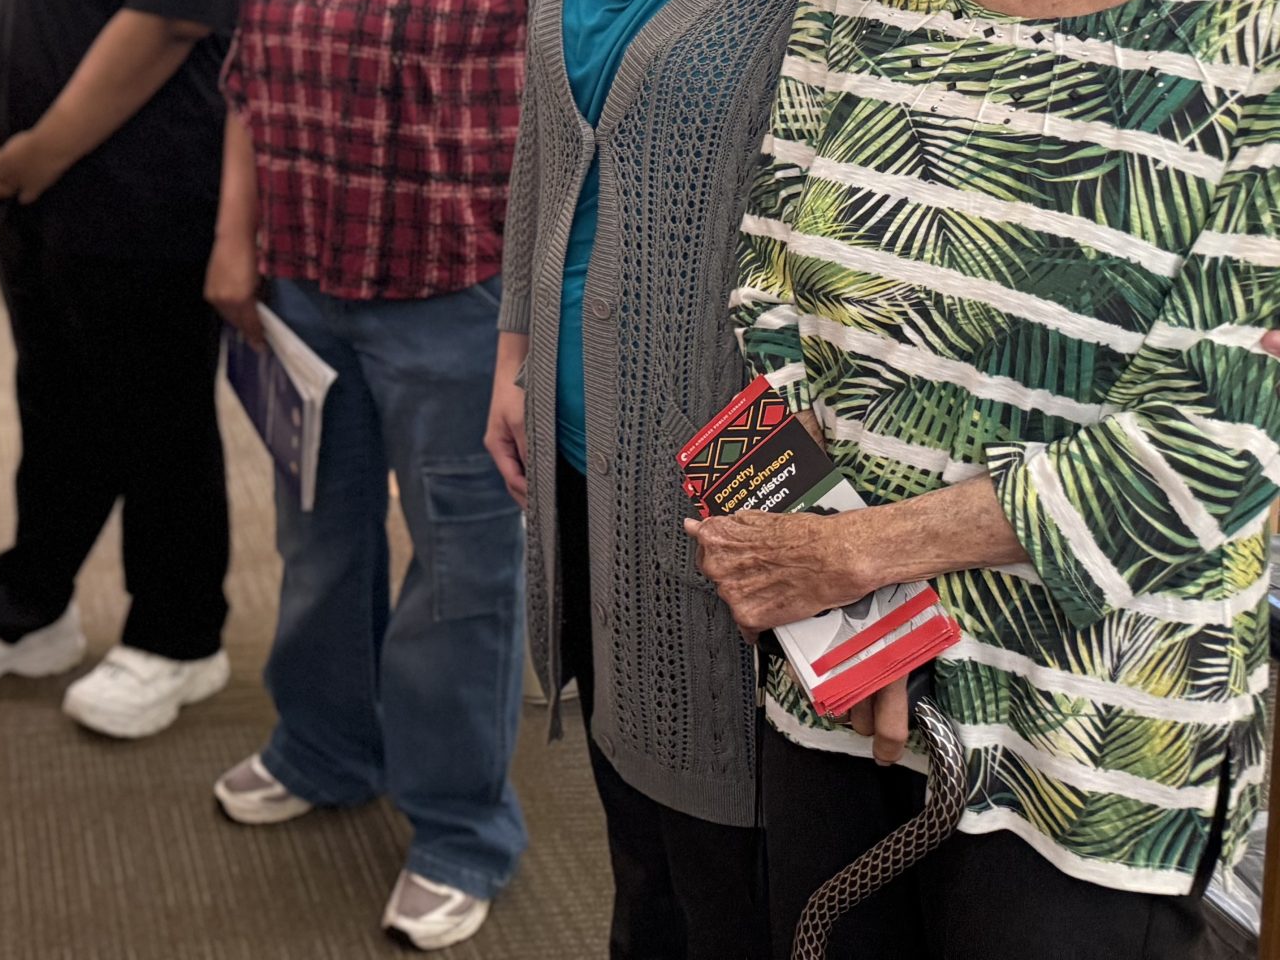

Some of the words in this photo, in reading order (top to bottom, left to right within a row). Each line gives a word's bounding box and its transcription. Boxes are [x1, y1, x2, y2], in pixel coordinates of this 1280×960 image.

[686, 446, 696, 455] LOS
[695, 428, 714, 446] ANGELES
[713, 414, 729, 429] PUBLIC
[728, 398, 747, 416] LIBRARY
[714, 464, 755, 504] Dorothy
[721, 487, 748, 513] Vena
[748, 449, 794, 490] Johnson
[756, 463, 797, 500] History
